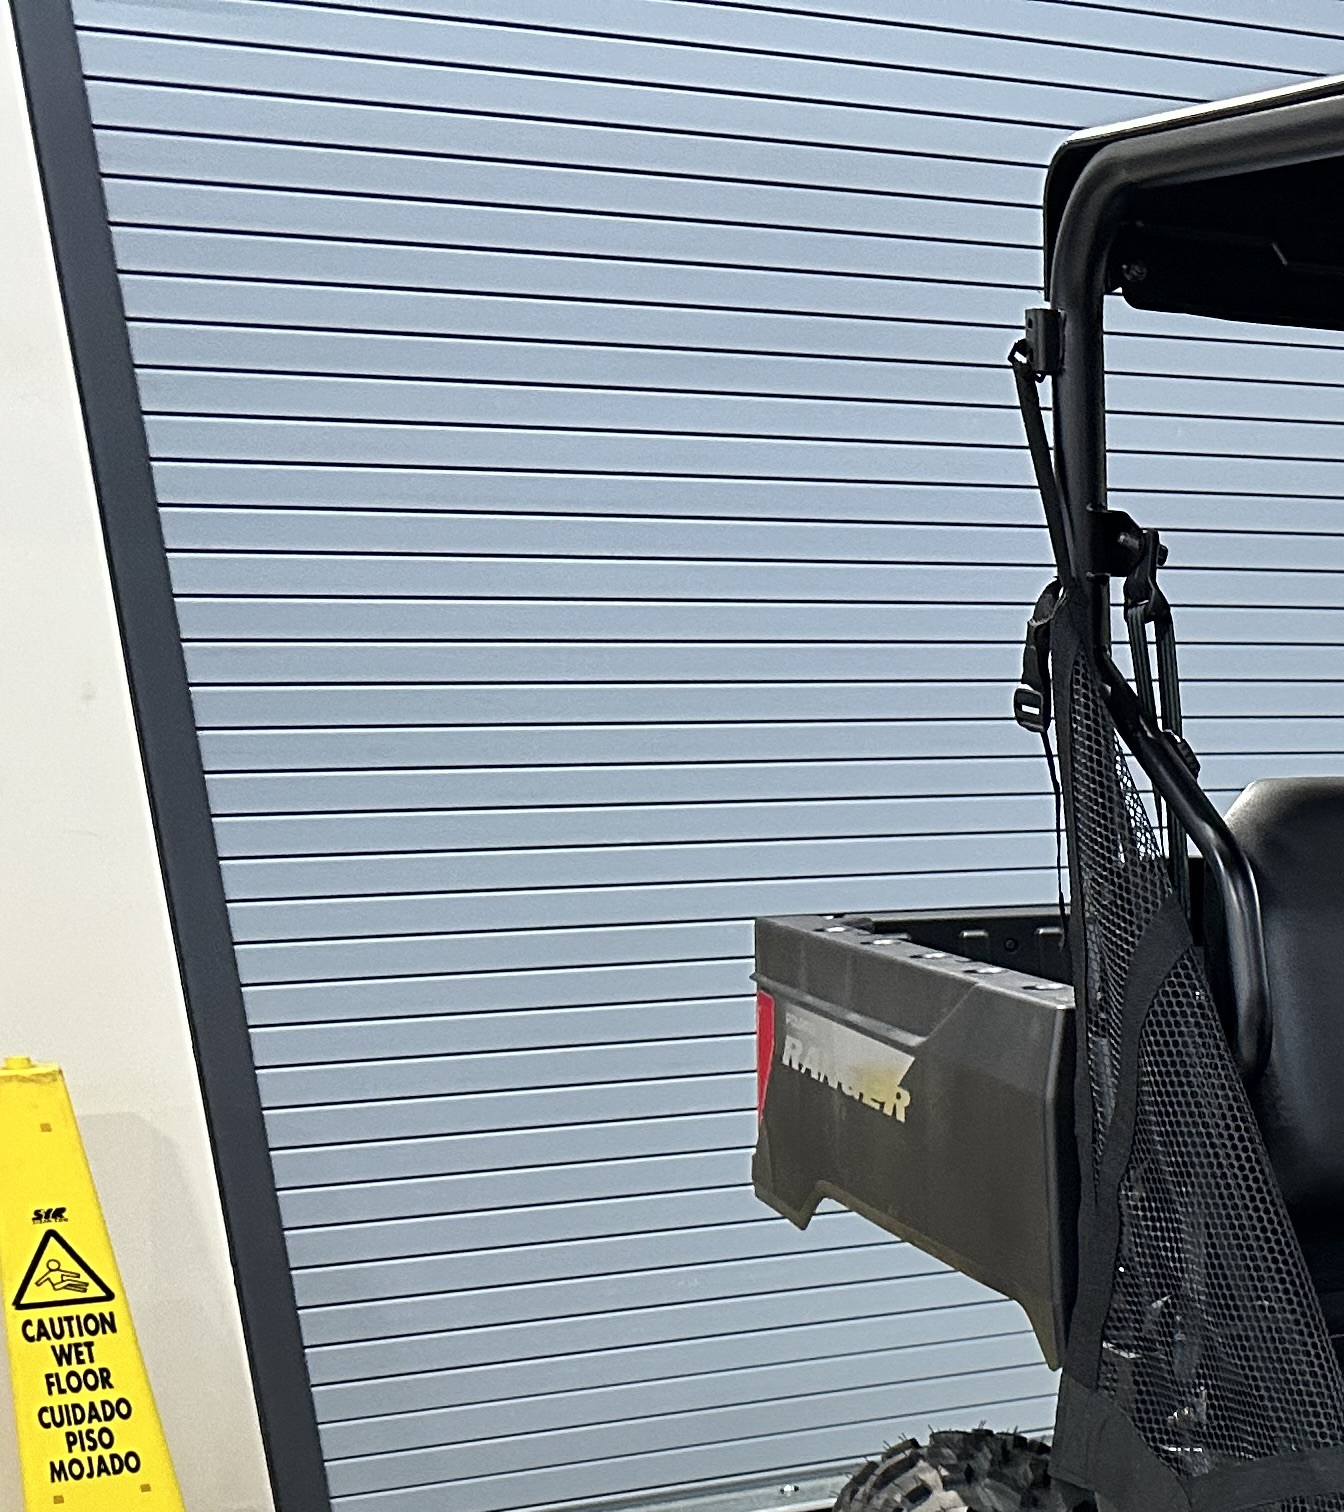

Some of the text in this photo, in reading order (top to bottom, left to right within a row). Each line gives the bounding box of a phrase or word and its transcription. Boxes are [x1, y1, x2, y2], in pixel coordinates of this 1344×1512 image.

[21, 1311, 118, 1343] CAUTION
[50, 1340, 95, 1367] WET
[45, 1367, 114, 1396] FLOOR
[37, 1397, 133, 1430] CUIDADO
[65, 1426, 115, 1453] PISO
[49, 1450, 141, 1483] MOJADO
